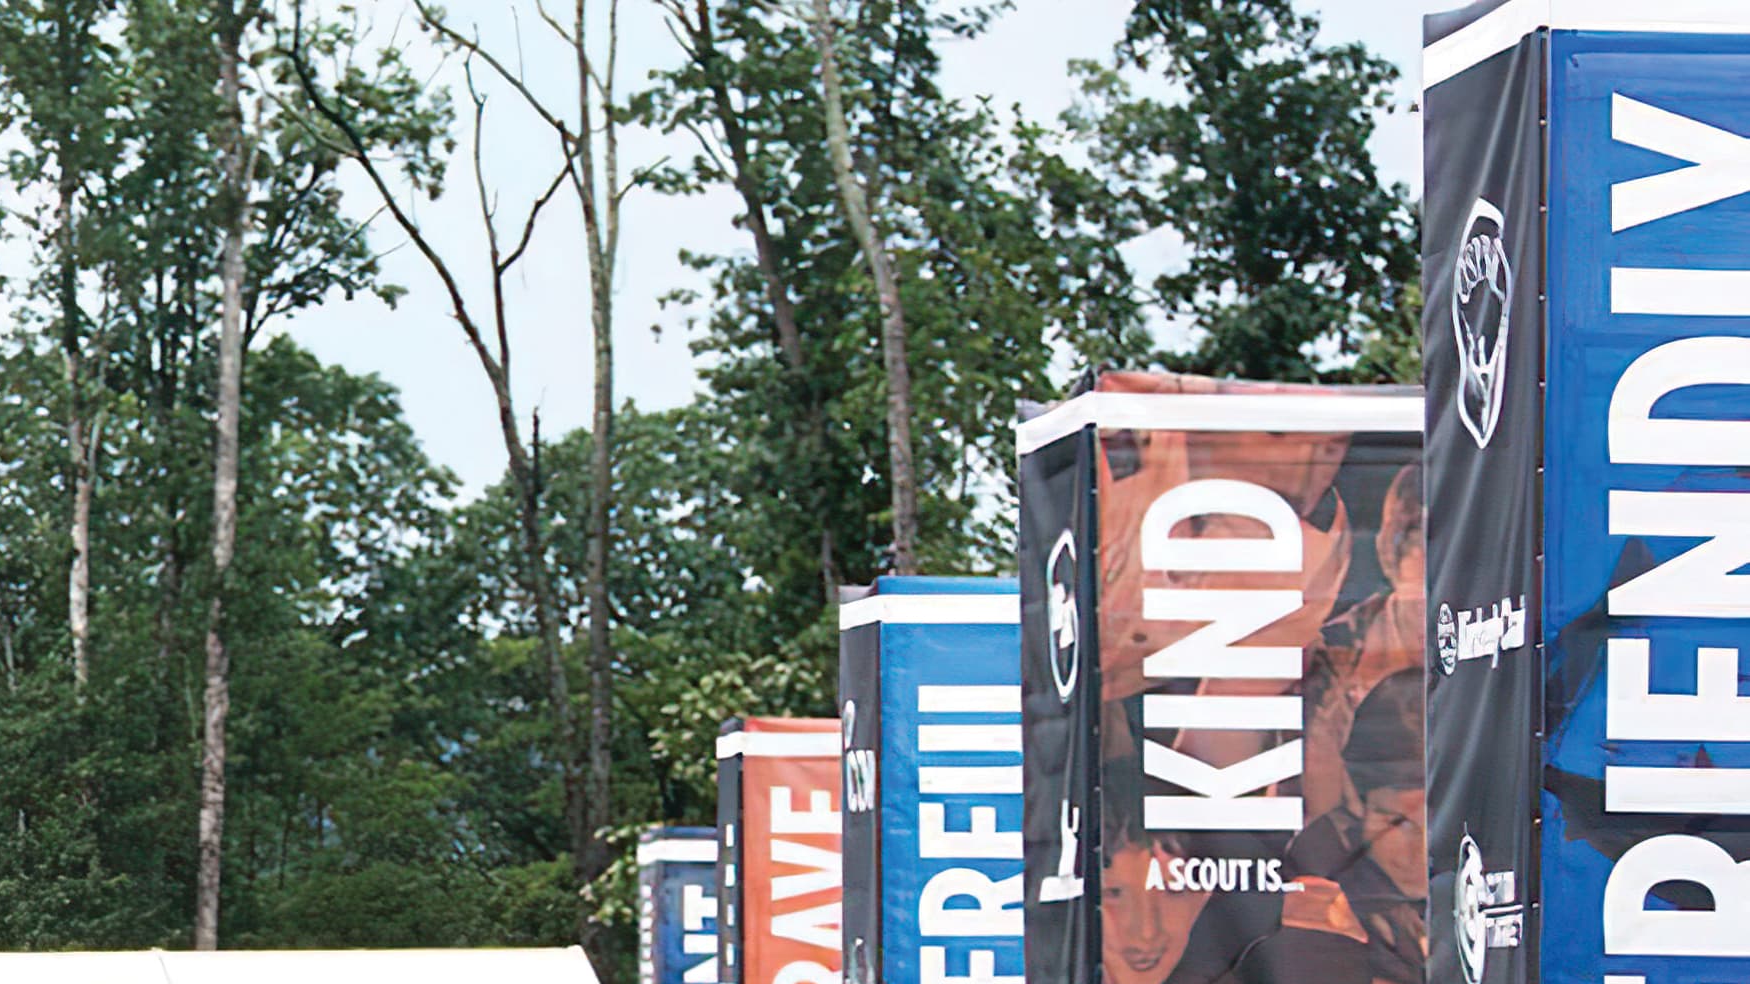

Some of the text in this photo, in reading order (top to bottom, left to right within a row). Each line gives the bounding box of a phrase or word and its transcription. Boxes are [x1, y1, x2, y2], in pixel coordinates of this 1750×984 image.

[1141, 478, 1303, 829] KIND
[1145, 858, 1164, 890] A
[1167, 858, 1252, 891] SCOUT
